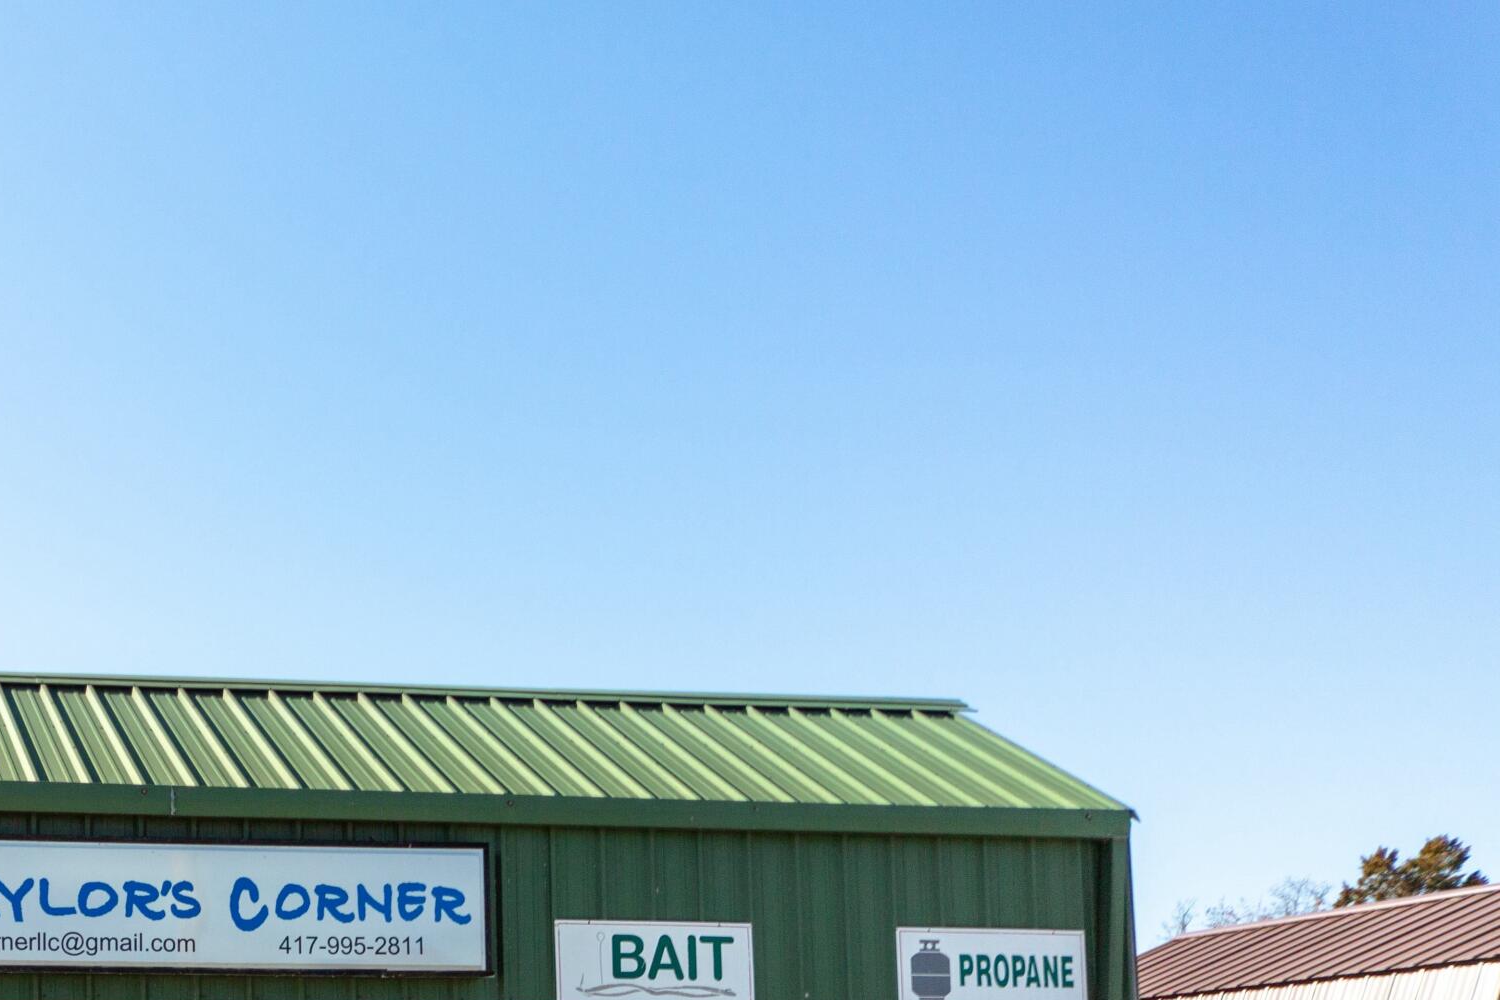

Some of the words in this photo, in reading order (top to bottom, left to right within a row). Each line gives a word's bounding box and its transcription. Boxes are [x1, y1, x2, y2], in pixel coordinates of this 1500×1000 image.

[229, 876, 472, 932] CORNER
[279, 936, 424, 955] 417-995-2811
[611, 934, 734, 981] BAIT
[959, 953, 1074, 988] PROPANE
